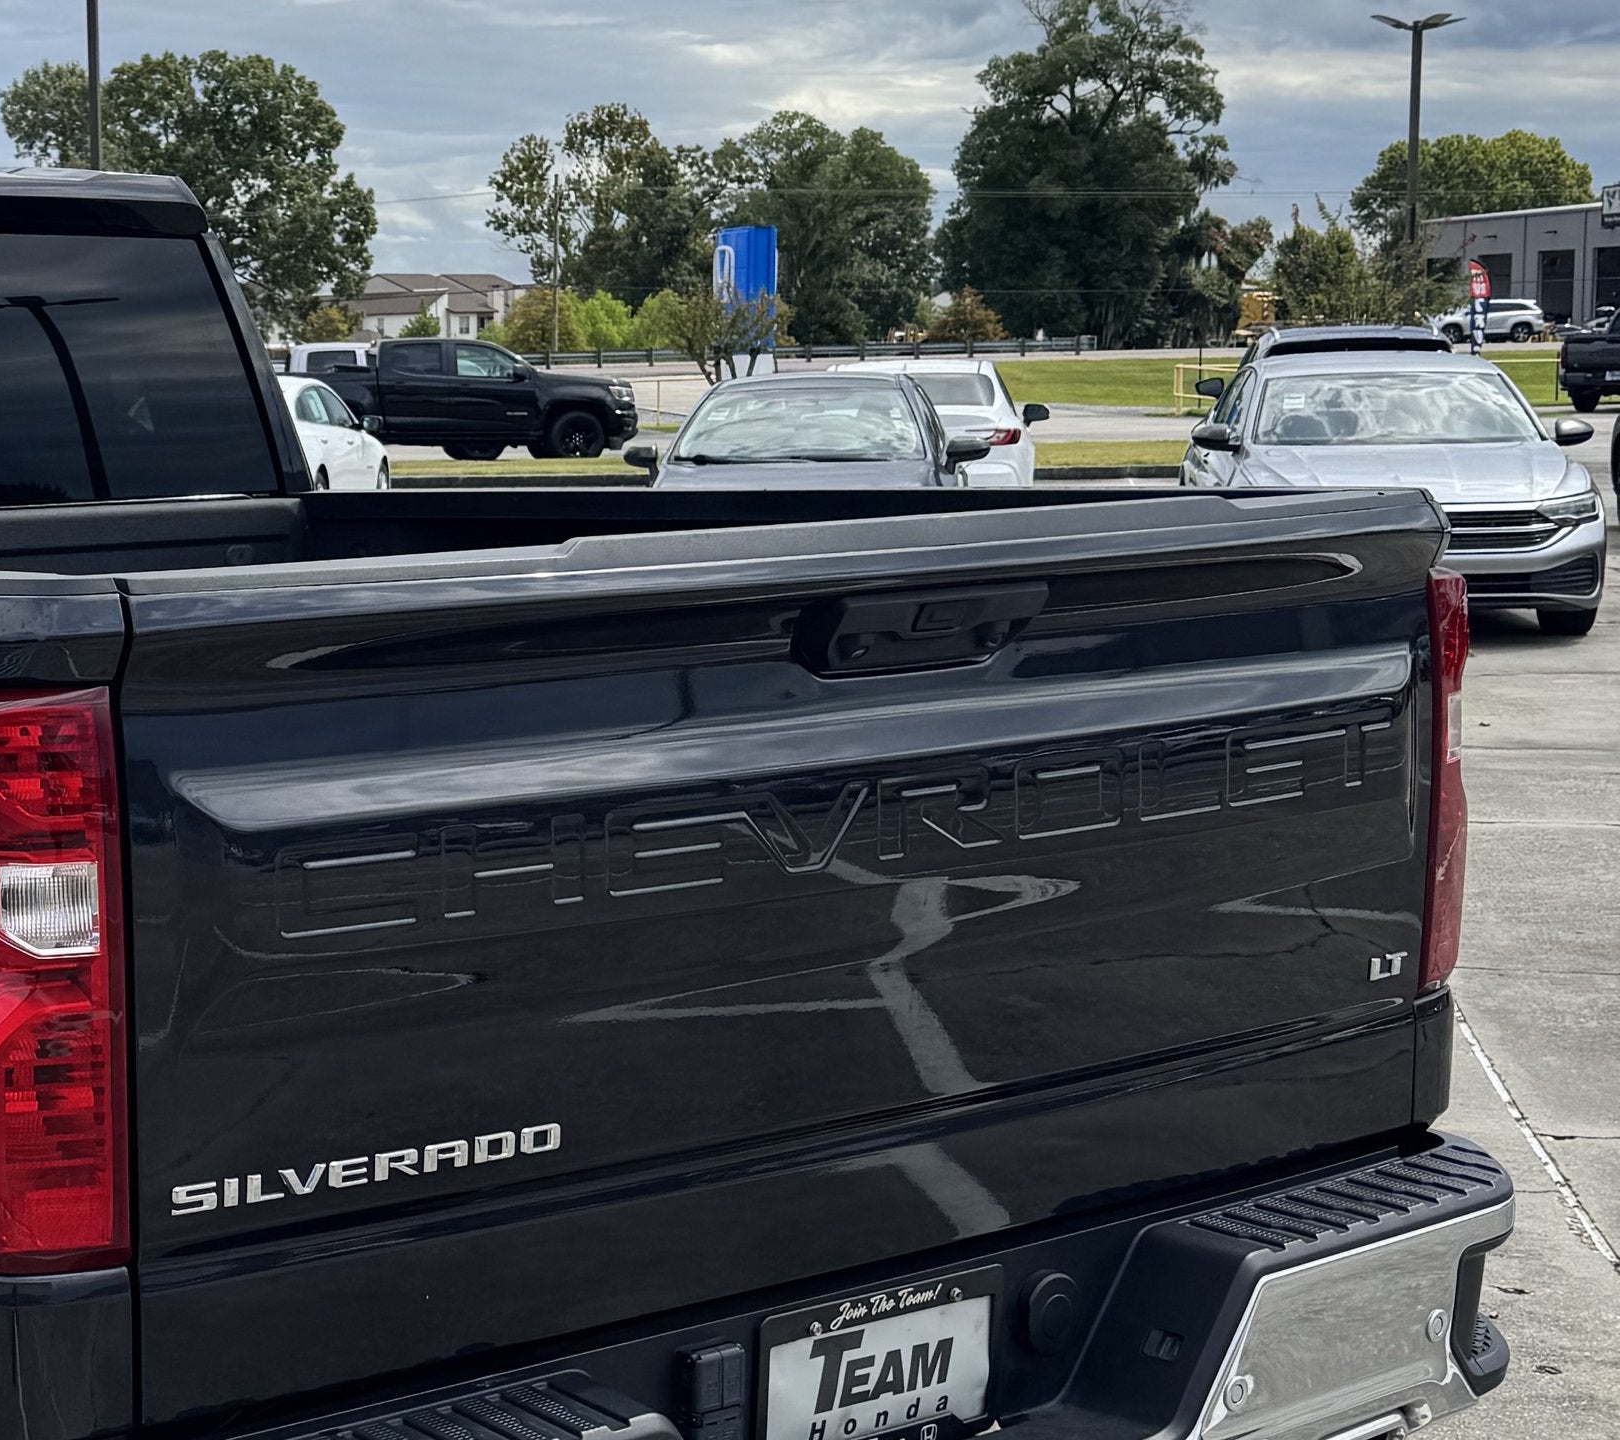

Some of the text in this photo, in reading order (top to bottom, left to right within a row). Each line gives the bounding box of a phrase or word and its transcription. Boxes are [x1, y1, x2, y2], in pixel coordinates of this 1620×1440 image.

[275, 711, 1393, 938] CHEVROLET
[1369, 951, 1408, 981] LT
[171, 1122, 562, 1216] SILVERADO
[830, 1283, 942, 1330] Join The Team!
[809, 1329, 954, 1415] TEAM
